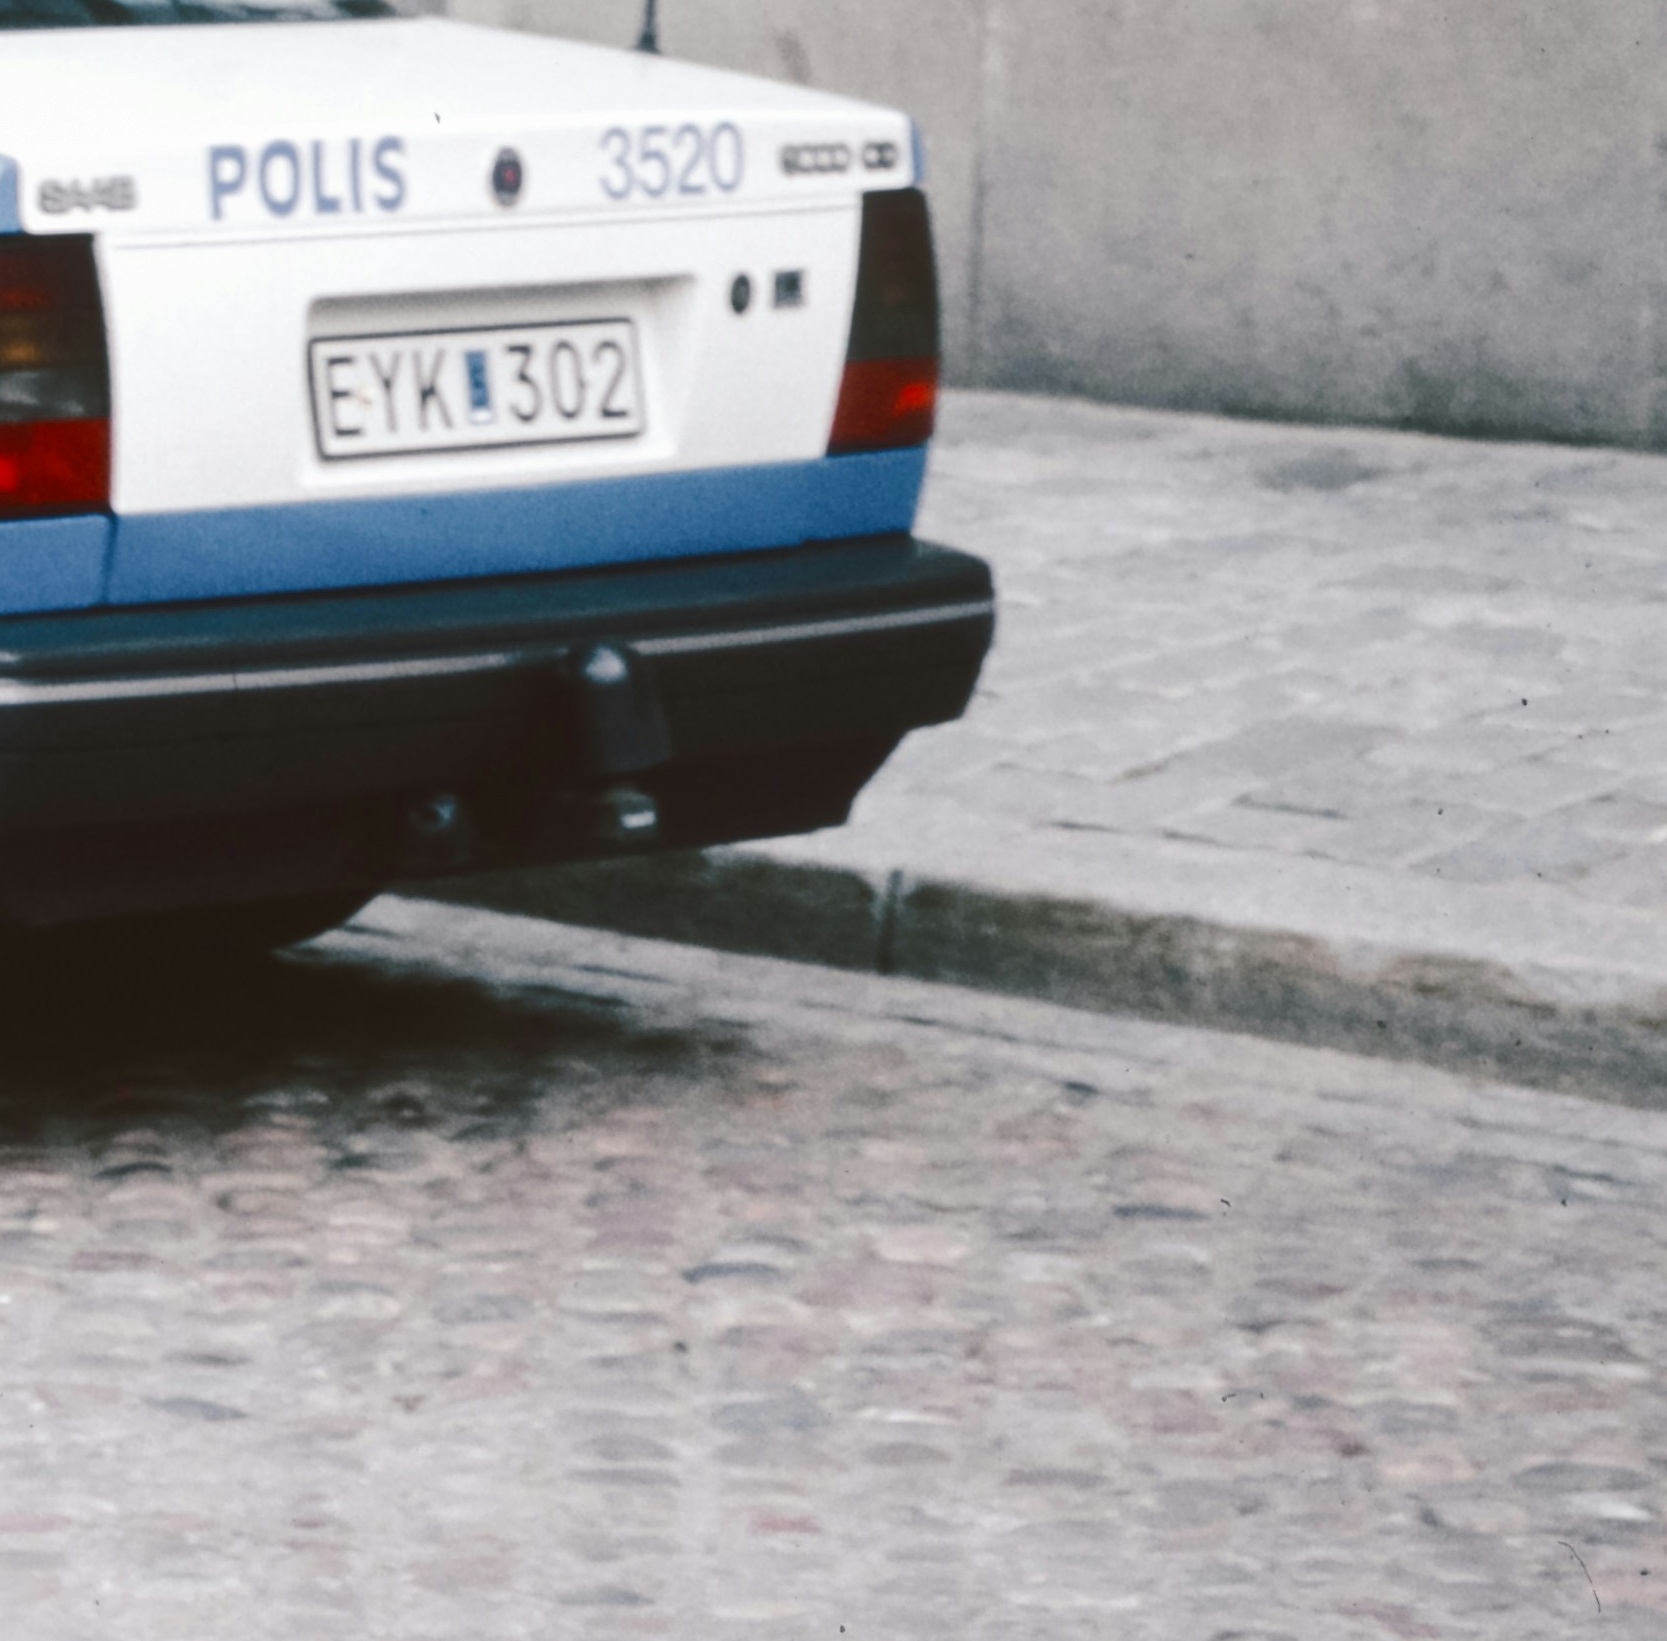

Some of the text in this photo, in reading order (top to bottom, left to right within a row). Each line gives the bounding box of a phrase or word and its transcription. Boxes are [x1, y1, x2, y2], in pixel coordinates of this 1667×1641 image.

[38, 175, 137, 215] SAAB
[208, 135, 407, 221] POLIS
[599, 121, 744, 200] 3520
[327, 340, 628, 437] EYK 302
